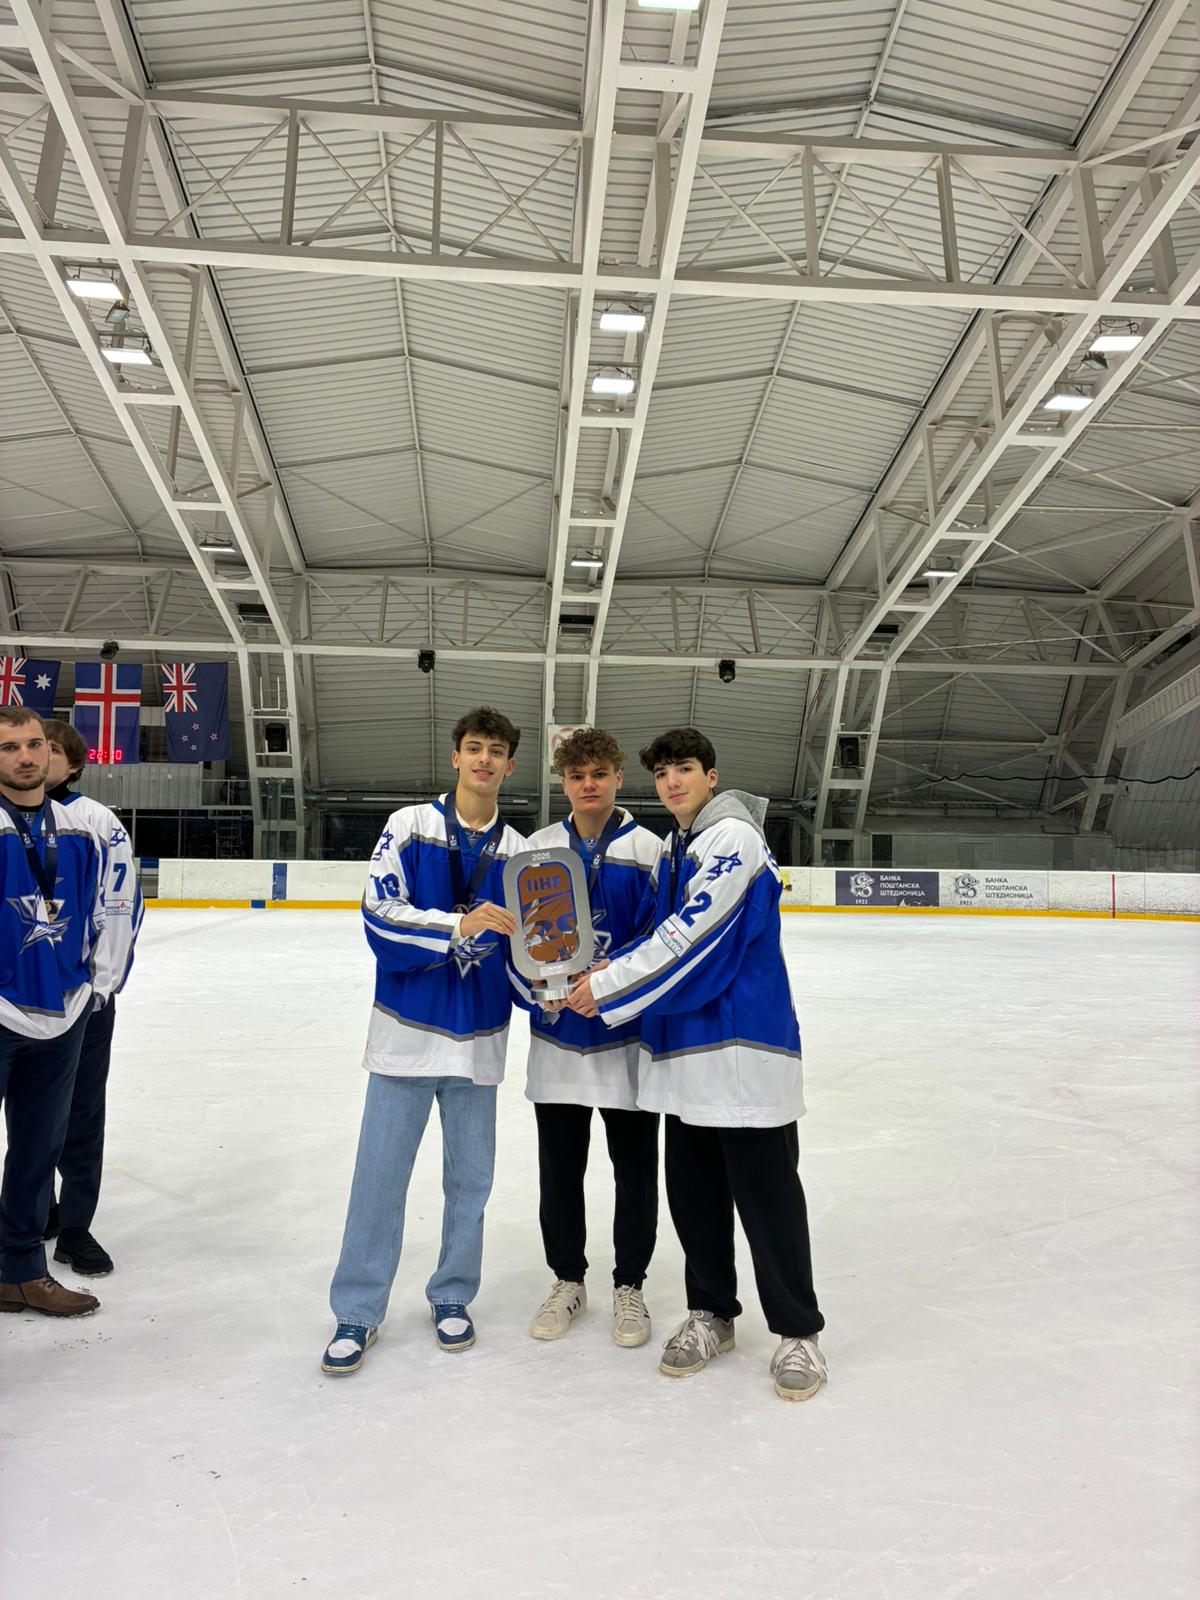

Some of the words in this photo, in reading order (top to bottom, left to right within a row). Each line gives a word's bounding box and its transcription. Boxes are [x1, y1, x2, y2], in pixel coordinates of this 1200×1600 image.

[531, 852, 551, 861] 2026
[113, 863, 127, 892] 7
[526, 875, 561, 892] IIHF
[680, 891, 712, 928] 2
